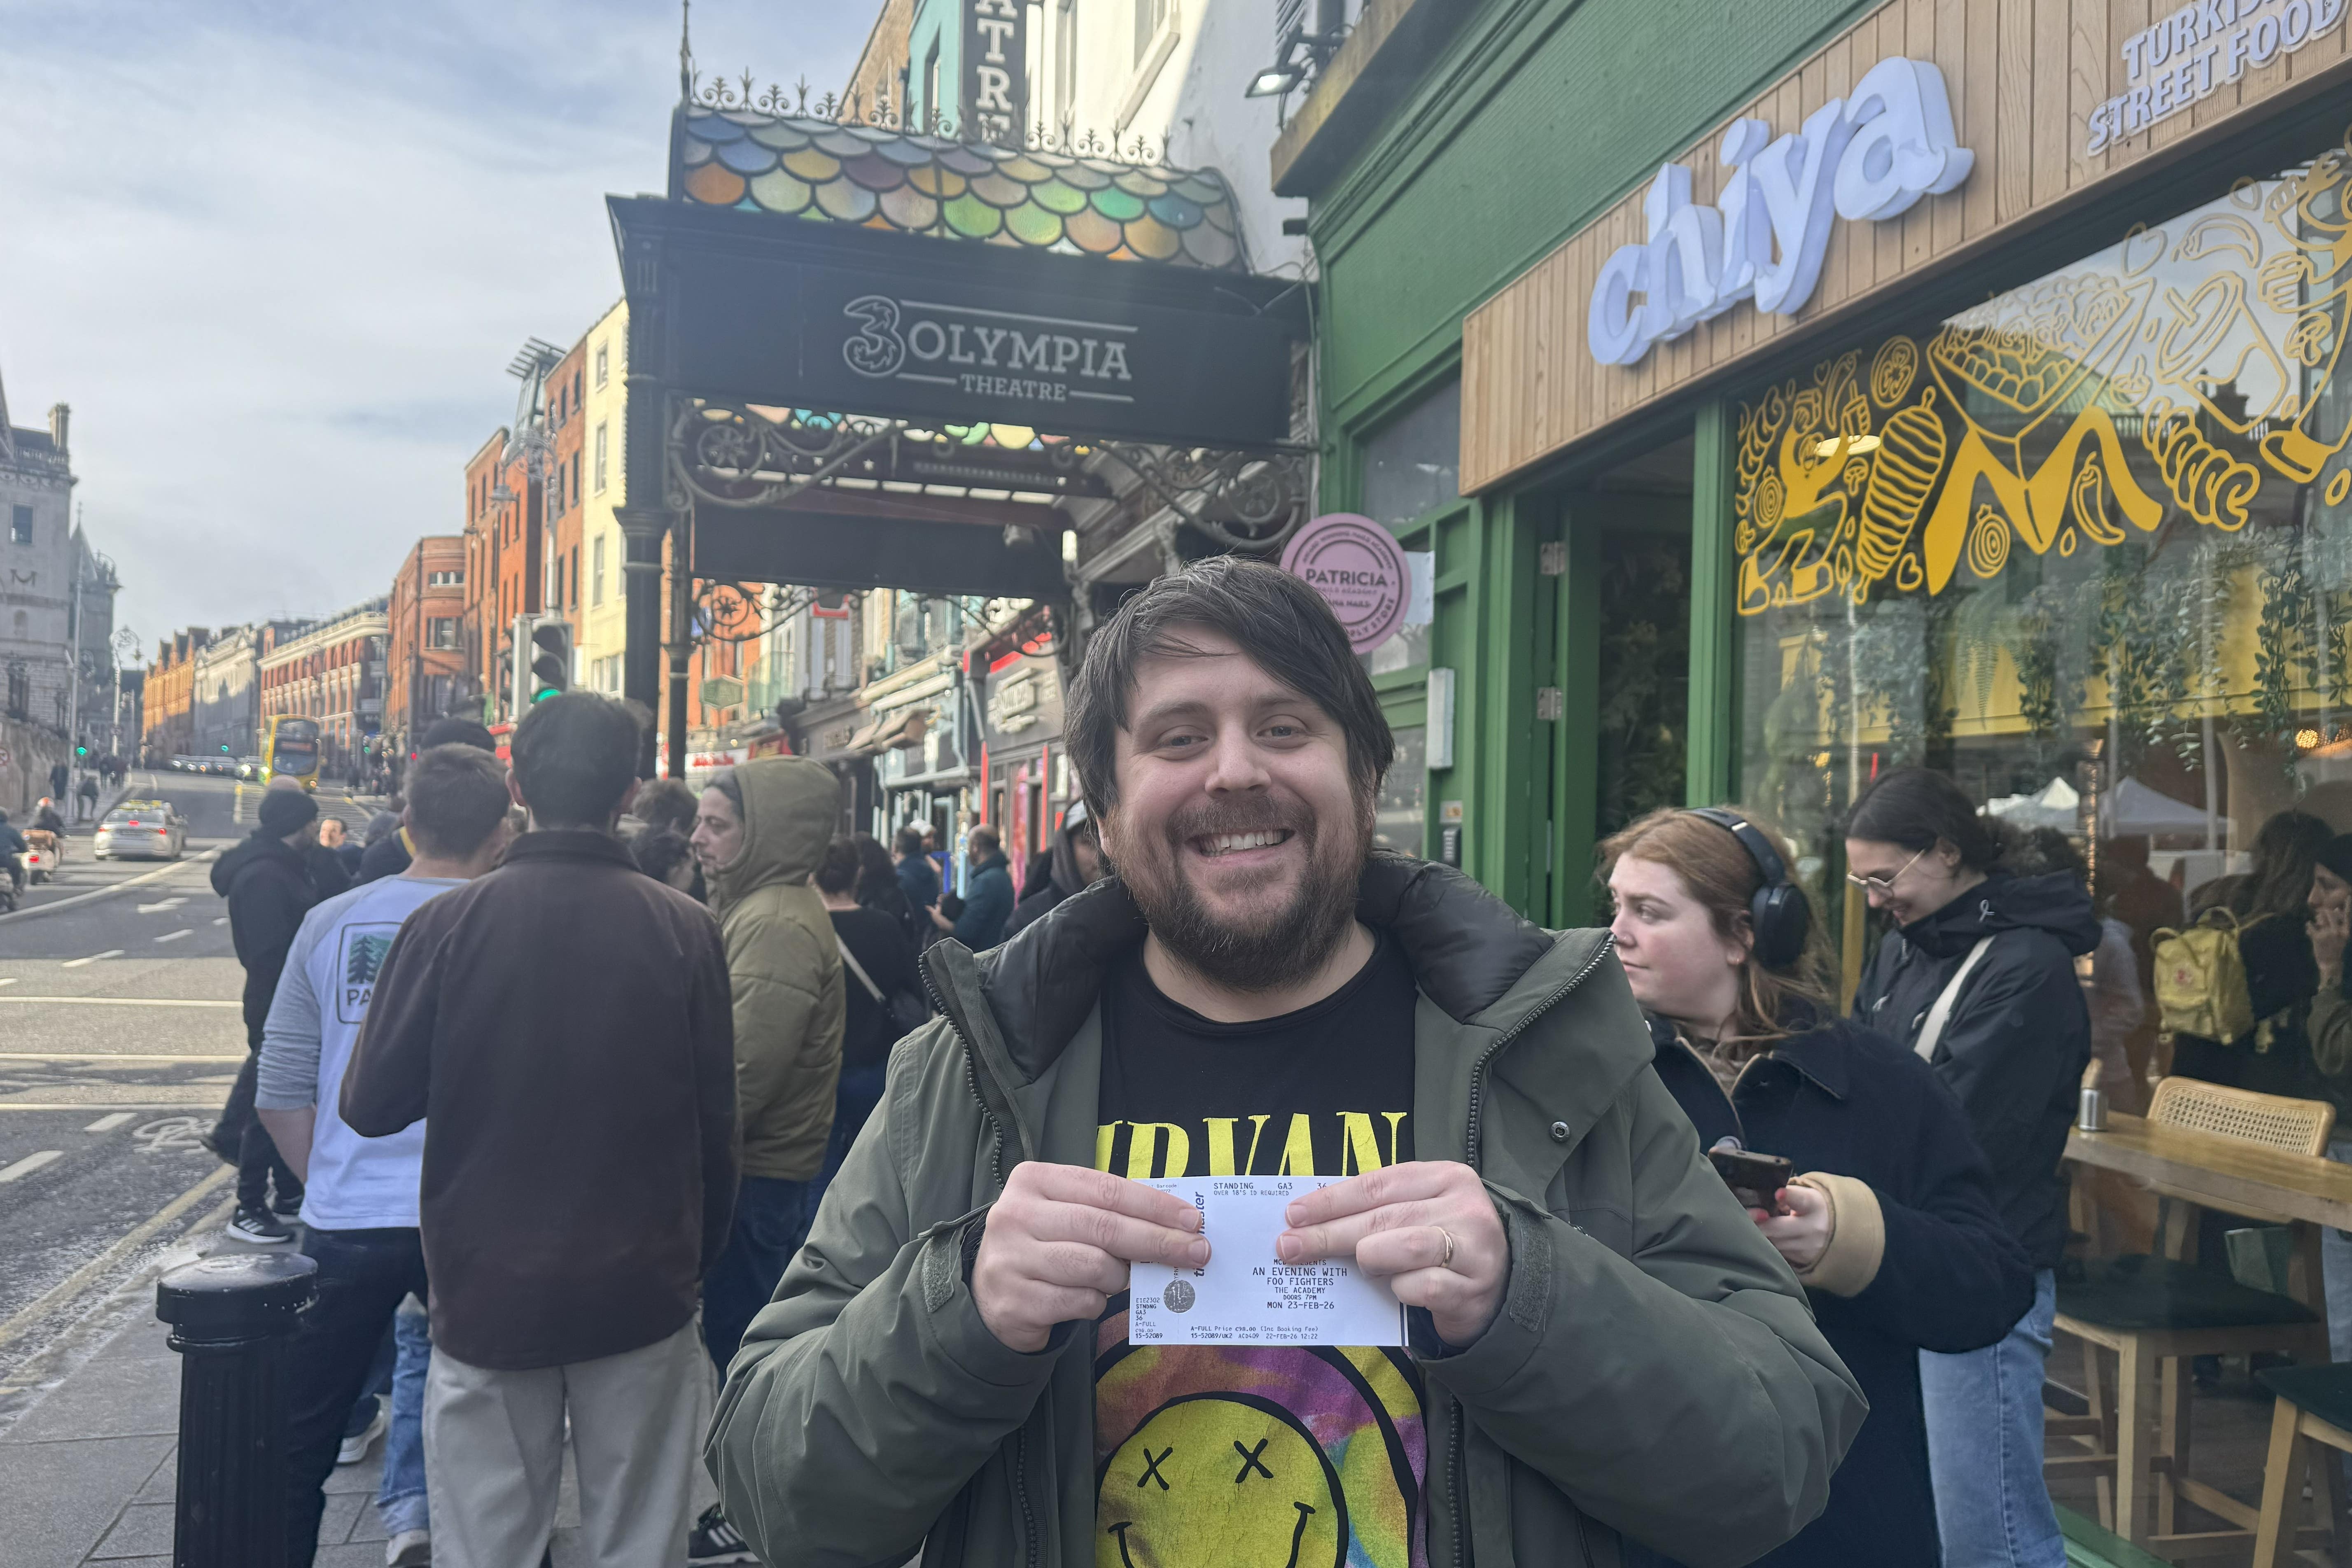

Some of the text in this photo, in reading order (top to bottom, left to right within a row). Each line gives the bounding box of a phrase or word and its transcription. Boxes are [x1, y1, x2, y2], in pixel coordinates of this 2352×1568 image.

[2123, 0, 2281, 80] TURKI
[2087, 0, 2343, 151] STREET FOOD
[1587, 56, 1974, 365] chiya
[908, 320, 1132, 380] OLYMPIA
[960, 373, 1066, 402] THEATRE
[1306, 568, 1388, 587] PATRICIA
[347, 989, 371, 1006] PA
[1253, 1267, 1347, 1276] AN EVENING WITH
[1290, 1277, 1334, 1286] FIGHTERS
